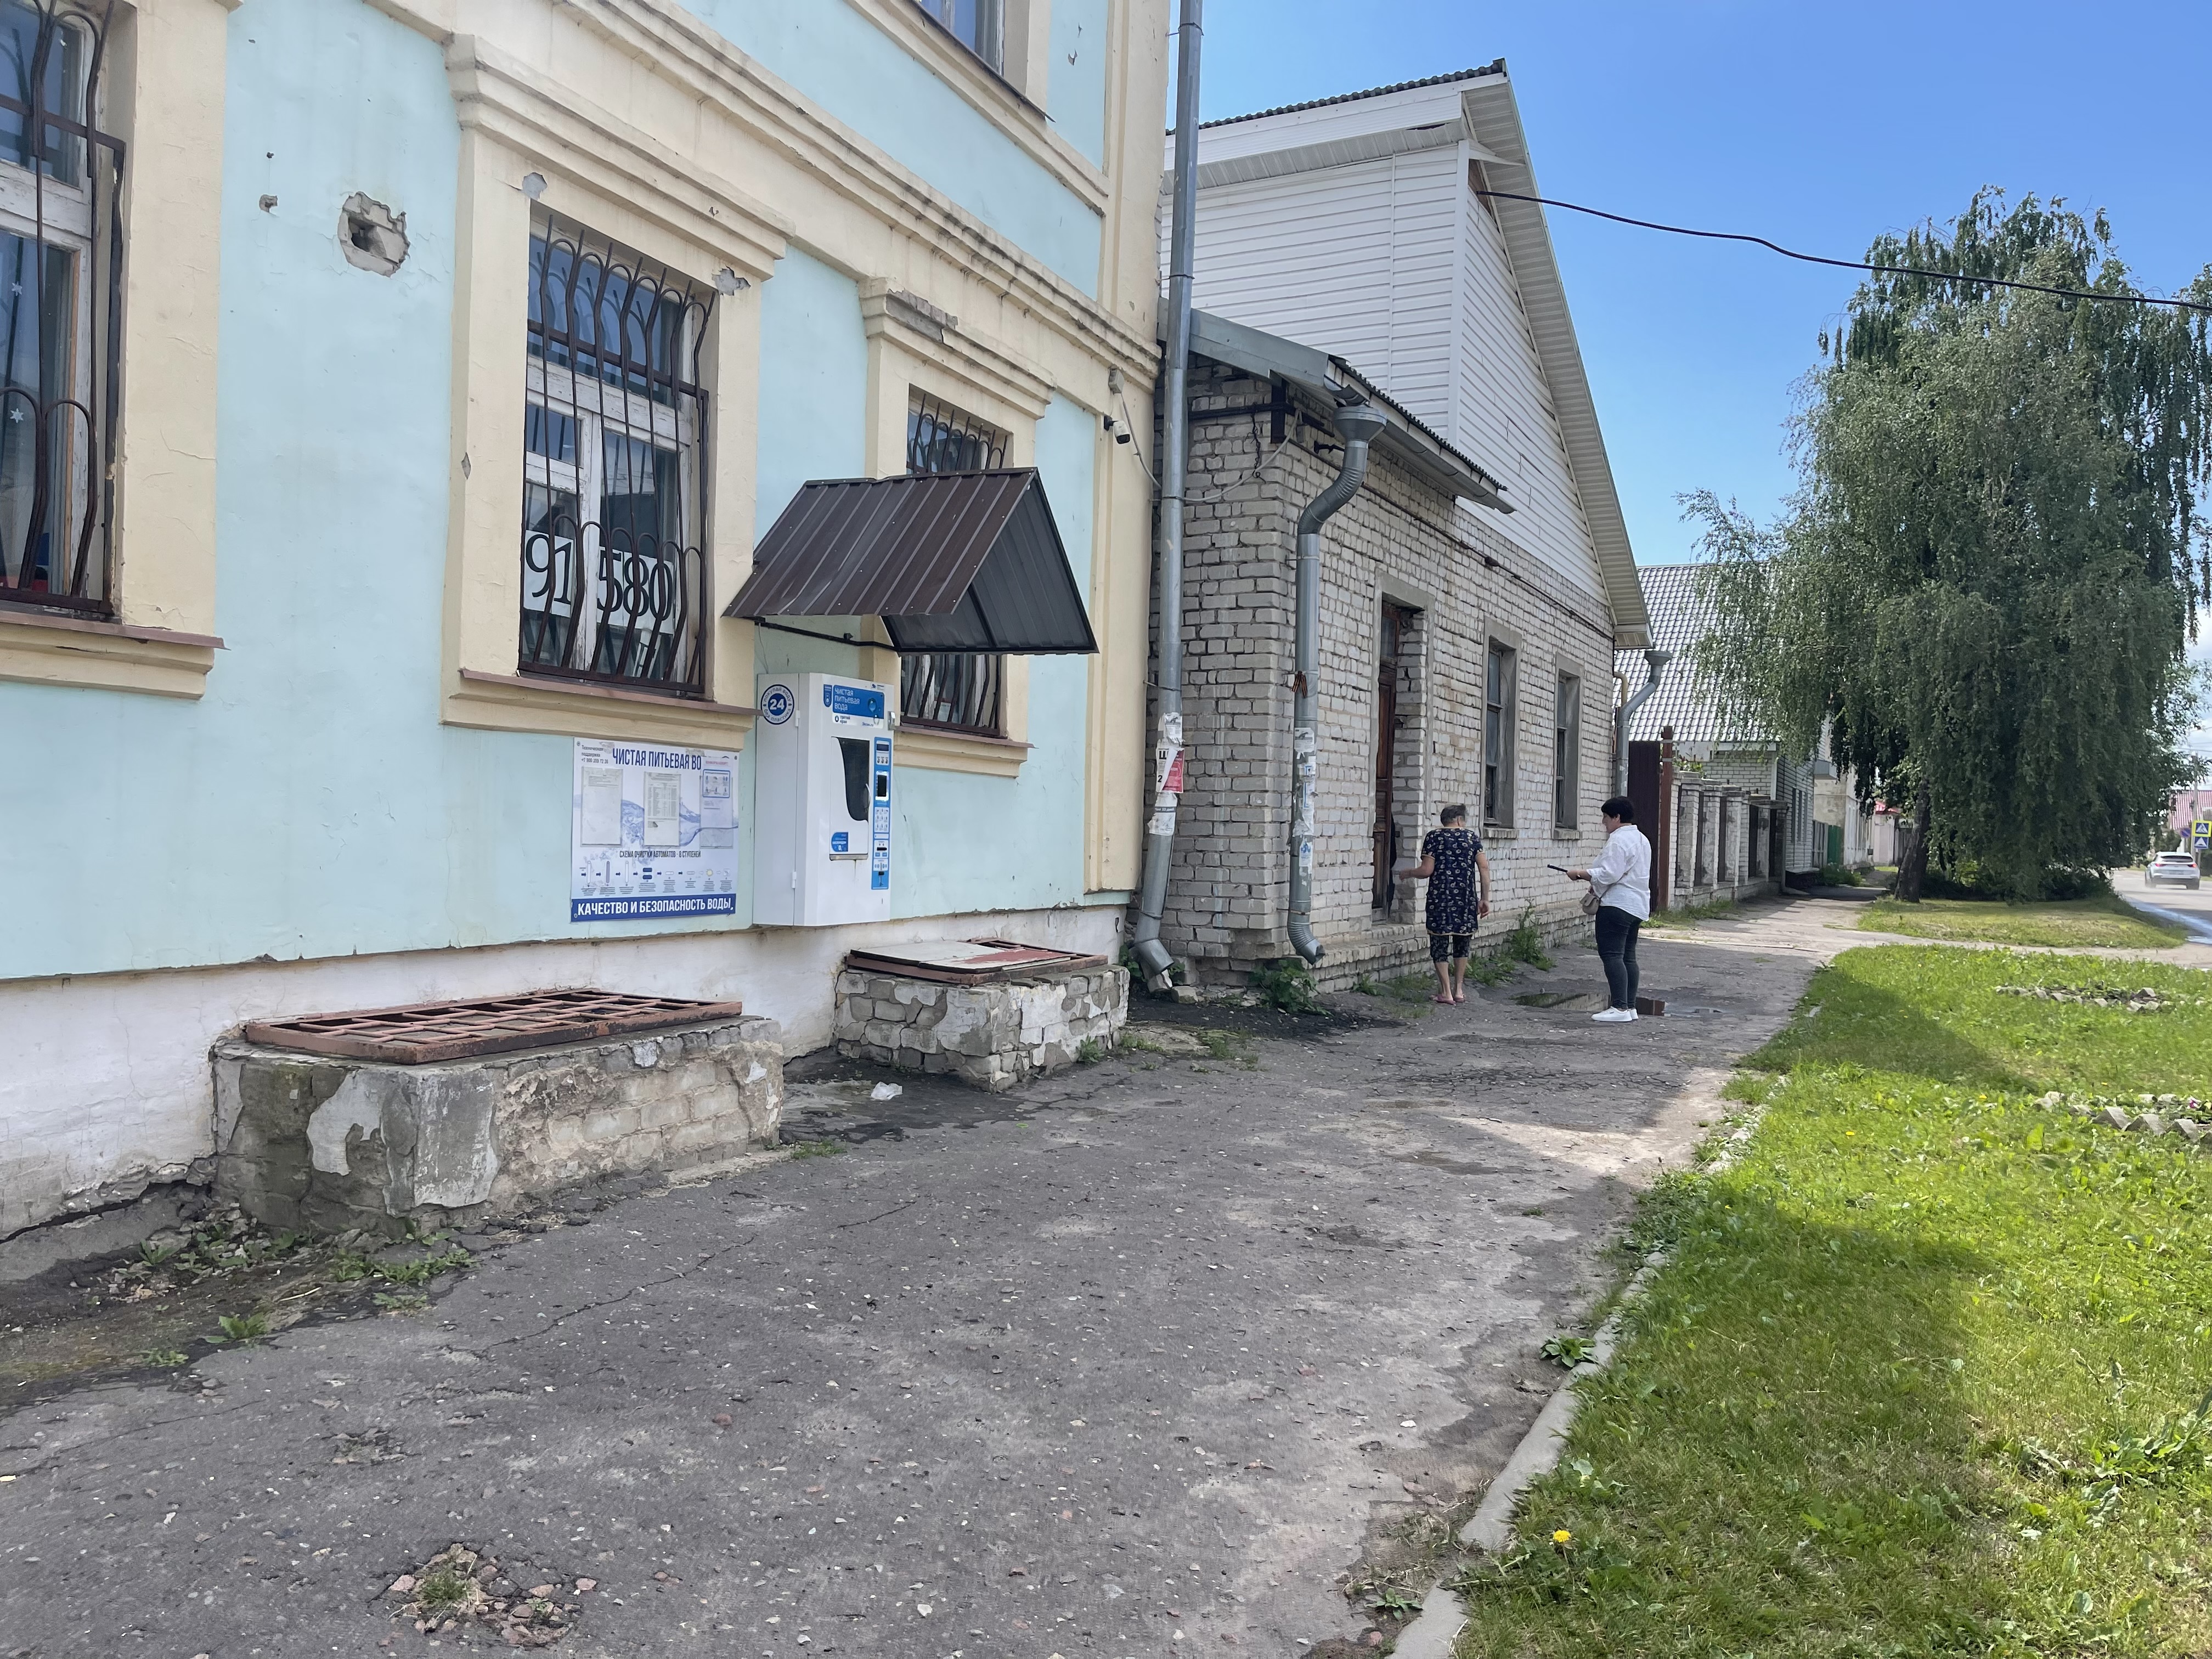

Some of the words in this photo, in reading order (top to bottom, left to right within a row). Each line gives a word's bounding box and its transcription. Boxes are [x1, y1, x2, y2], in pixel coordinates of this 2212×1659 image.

[526, 534, 572, 606] 91
[834, 687, 854, 696] чистая
[770, 698, 785, 710] 24
[834, 695, 860, 705] питьевая
[834, 703, 848, 712] вода
[612, 748, 646, 766] ЧИСТАЯ
[648, 751, 689, 769] ПИТЬЕВАЯ
[578, 901, 628, 916] КАЧЕСТВО
[630, 900, 637, 913] И
[639, 899, 706, 913] БЕЗОПАСНОСТЬ
